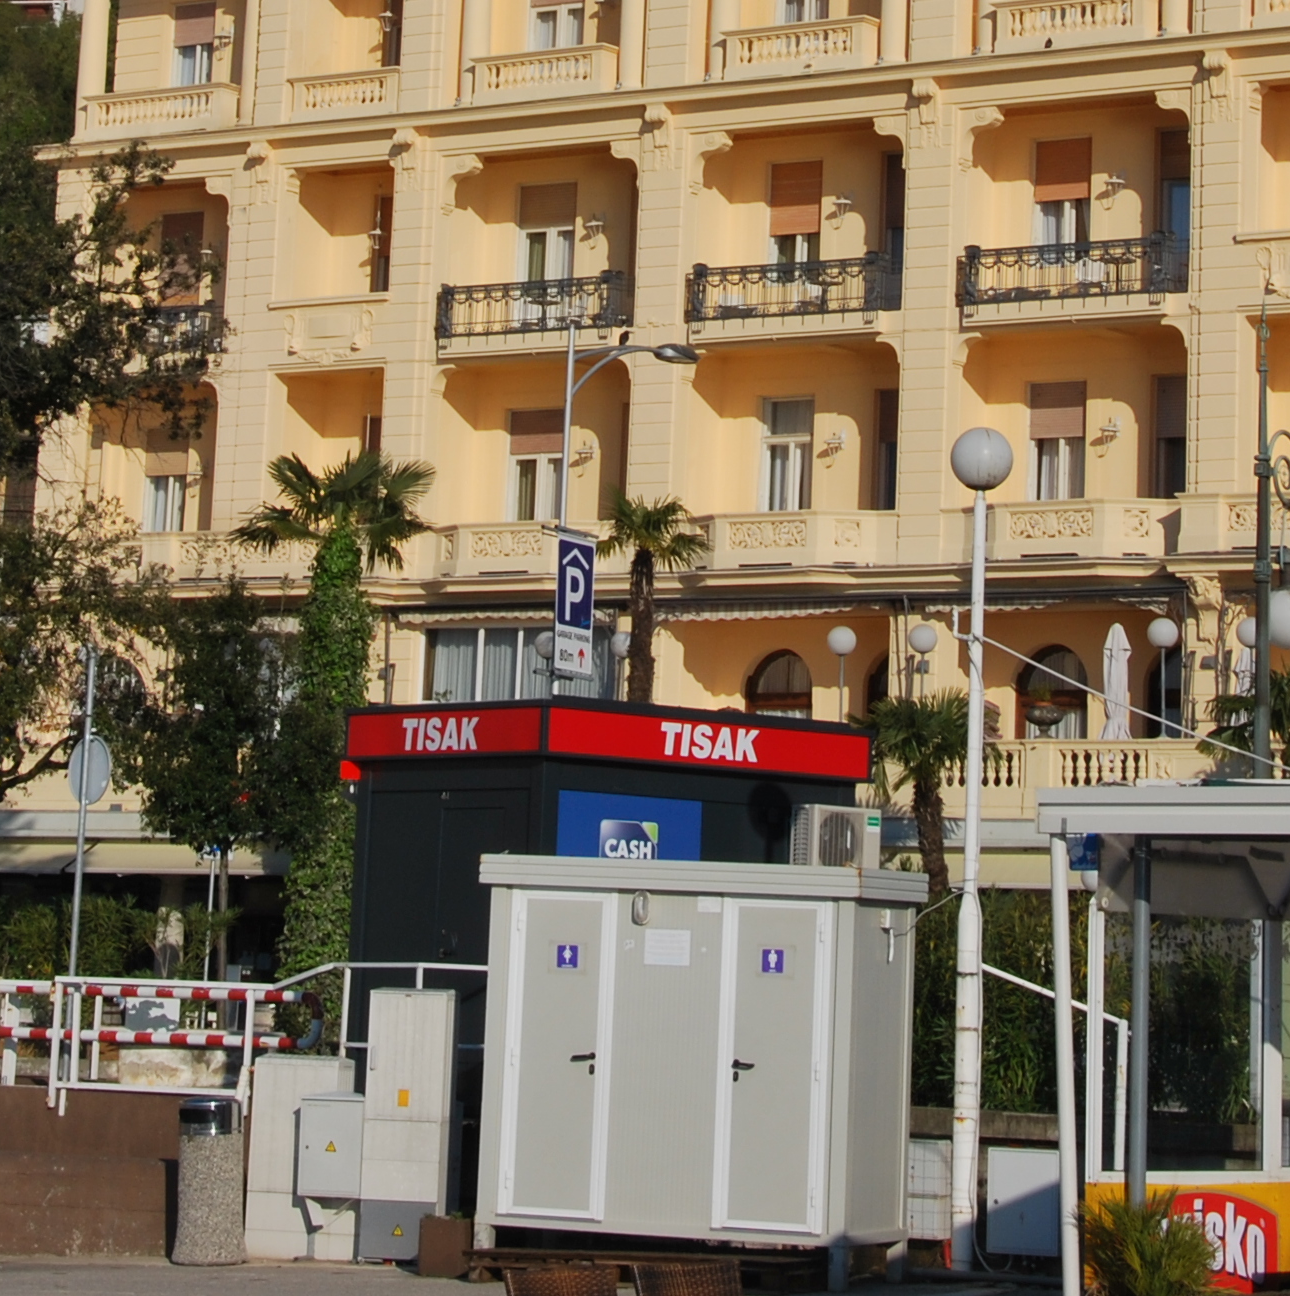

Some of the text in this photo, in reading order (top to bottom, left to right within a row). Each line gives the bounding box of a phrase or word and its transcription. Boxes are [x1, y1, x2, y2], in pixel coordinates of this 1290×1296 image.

[564, 565, 585, 622] P
[402, 716, 480, 751] TISAK
[660, 721, 760, 763] TISAK
[605, 838, 652, 859] CASH
